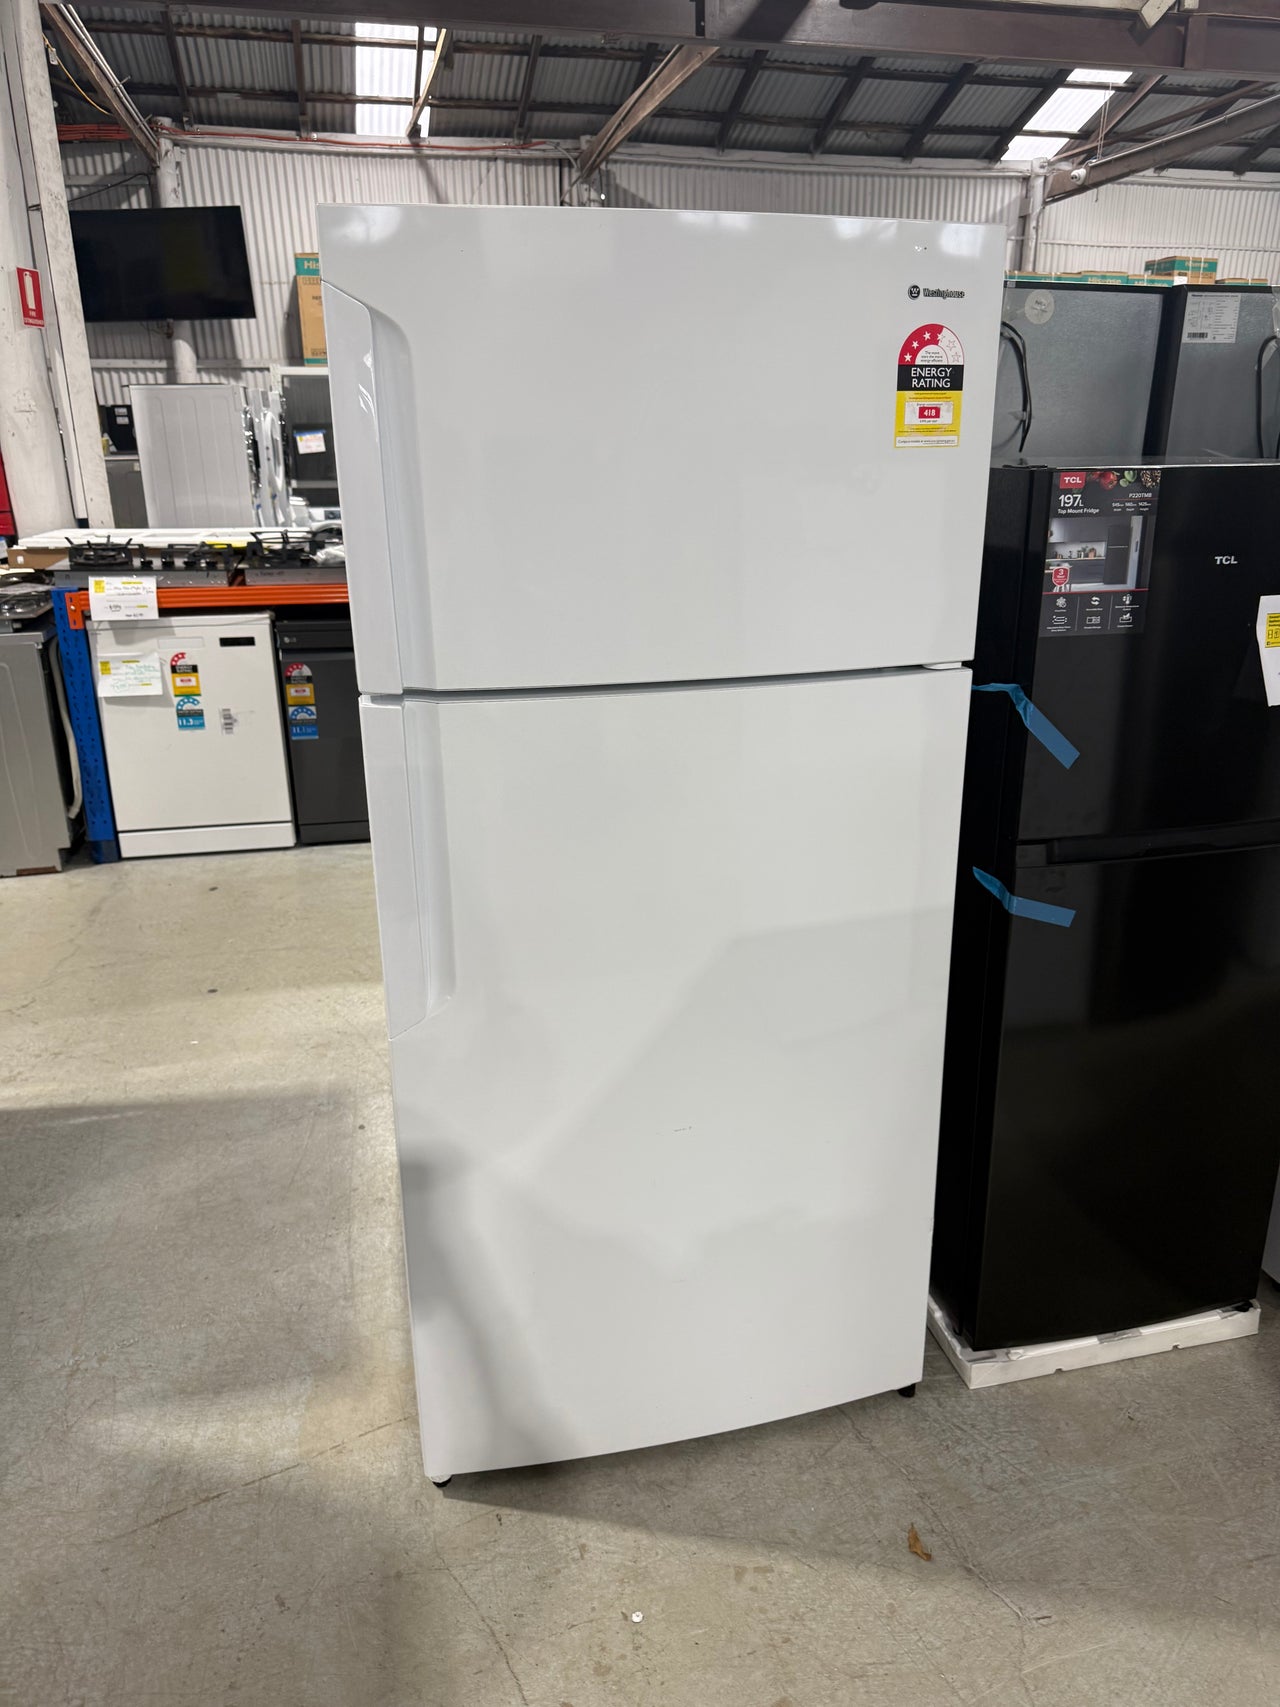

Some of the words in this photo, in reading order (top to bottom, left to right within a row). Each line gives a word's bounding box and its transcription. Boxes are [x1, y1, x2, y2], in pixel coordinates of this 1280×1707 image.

[923, 287, 965, 299] Westinghouse
[911, 367, 952, 377] ENERGY
[912, 378, 951, 388] RATING
[923, 409, 936, 417] 418
[1058, 494, 1084, 507] 197L
[1214, 555, 1238, 565] TCL
